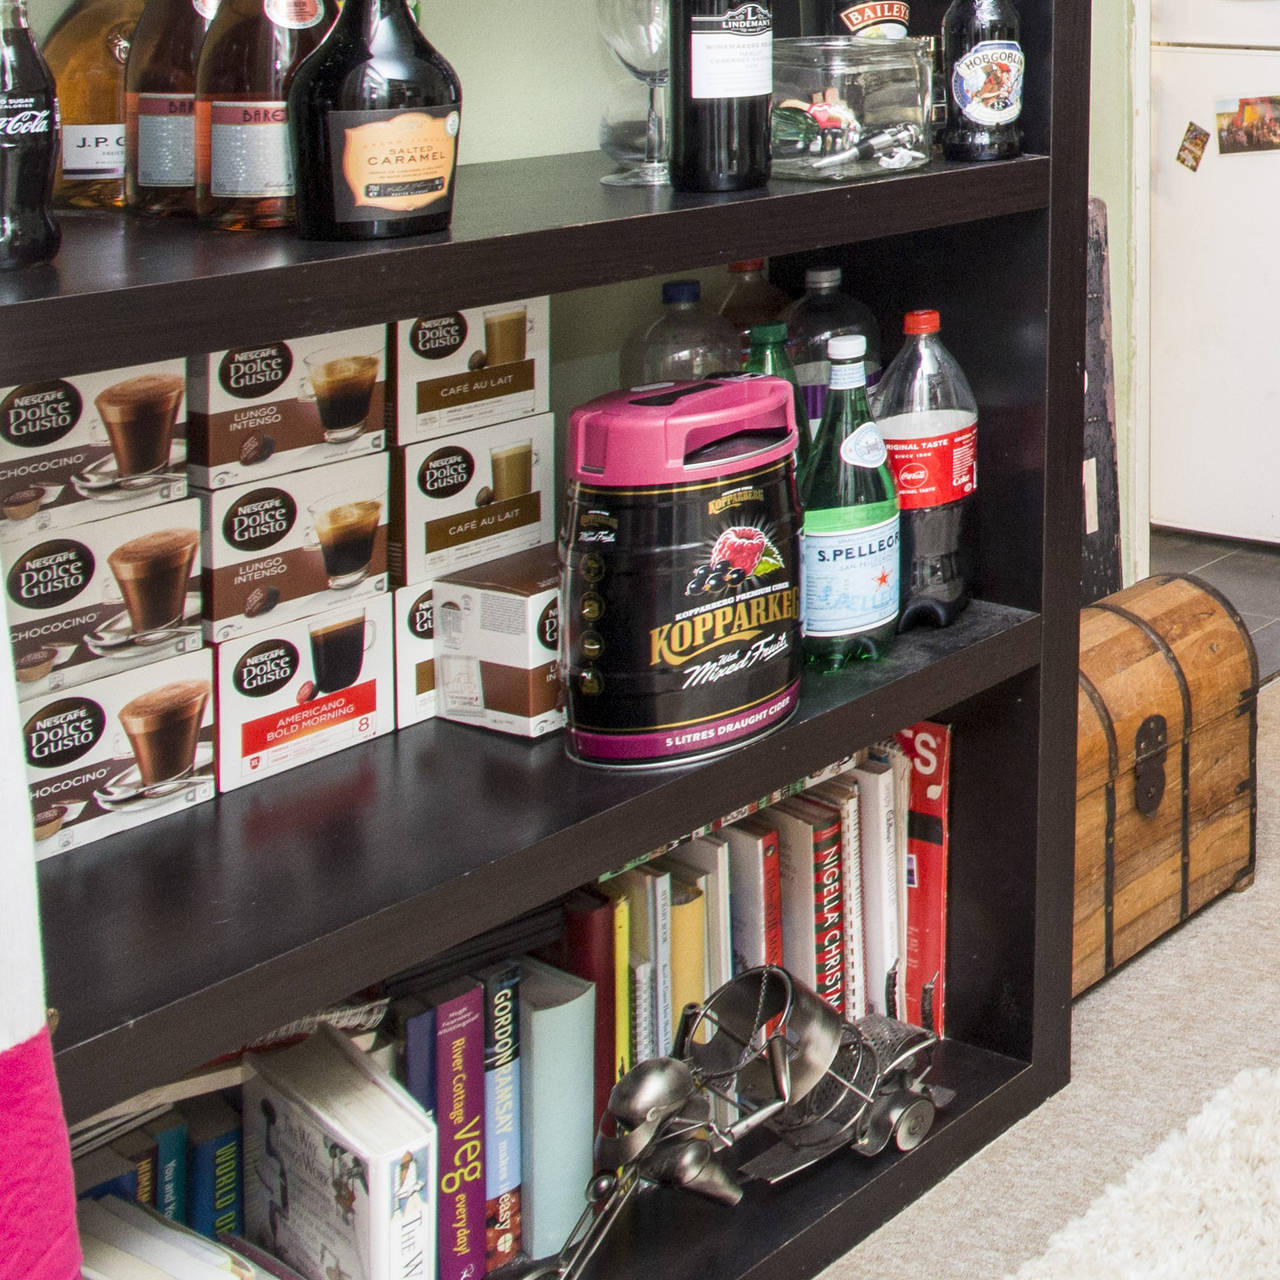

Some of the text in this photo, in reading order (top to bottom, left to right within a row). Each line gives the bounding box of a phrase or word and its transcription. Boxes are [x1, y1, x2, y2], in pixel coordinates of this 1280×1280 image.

[848, 4, 910, 24] BAILEYS
[367, 152, 447, 167] CARAMEL
[389, 145, 434, 156] SALTED
[440, 375, 514, 397] CAFÉ AU LAIT
[229, 414, 282, 432] INTENSO
[234, 406, 278, 422] LUNGO
[921, 438, 949, 449] TASTE
[953, 473, 970, 486] Coke
[448, 508, 520, 536] CAFÉ AU LAIT
[234, 565, 287, 585] INTENSO
[239, 557, 282, 575] LUNGO
[649, 586, 800, 666] KOPPARKEG
[682, 632, 789, 690] Mixed Fruit
[266, 704, 355, 742] BOLD MORNING
[276, 698, 345, 728] AMERICANO
[358, 717, 370, 732] 8
[666, 696, 791, 747] 5 LITRES DRAUGHT CIDER
[30, 768, 107, 800] HOCOCINO
[822, 845, 842, 1012] NIGELLA CHRISTM
[493, 988, 513, 1135] GORDON RAMSAY
[448, 1036, 467, 1125] River Cottage
[215, 1141, 238, 1235] WORLD OF
[452, 1193, 470, 1257] everyday!
[497, 1193, 512, 1230] easy
